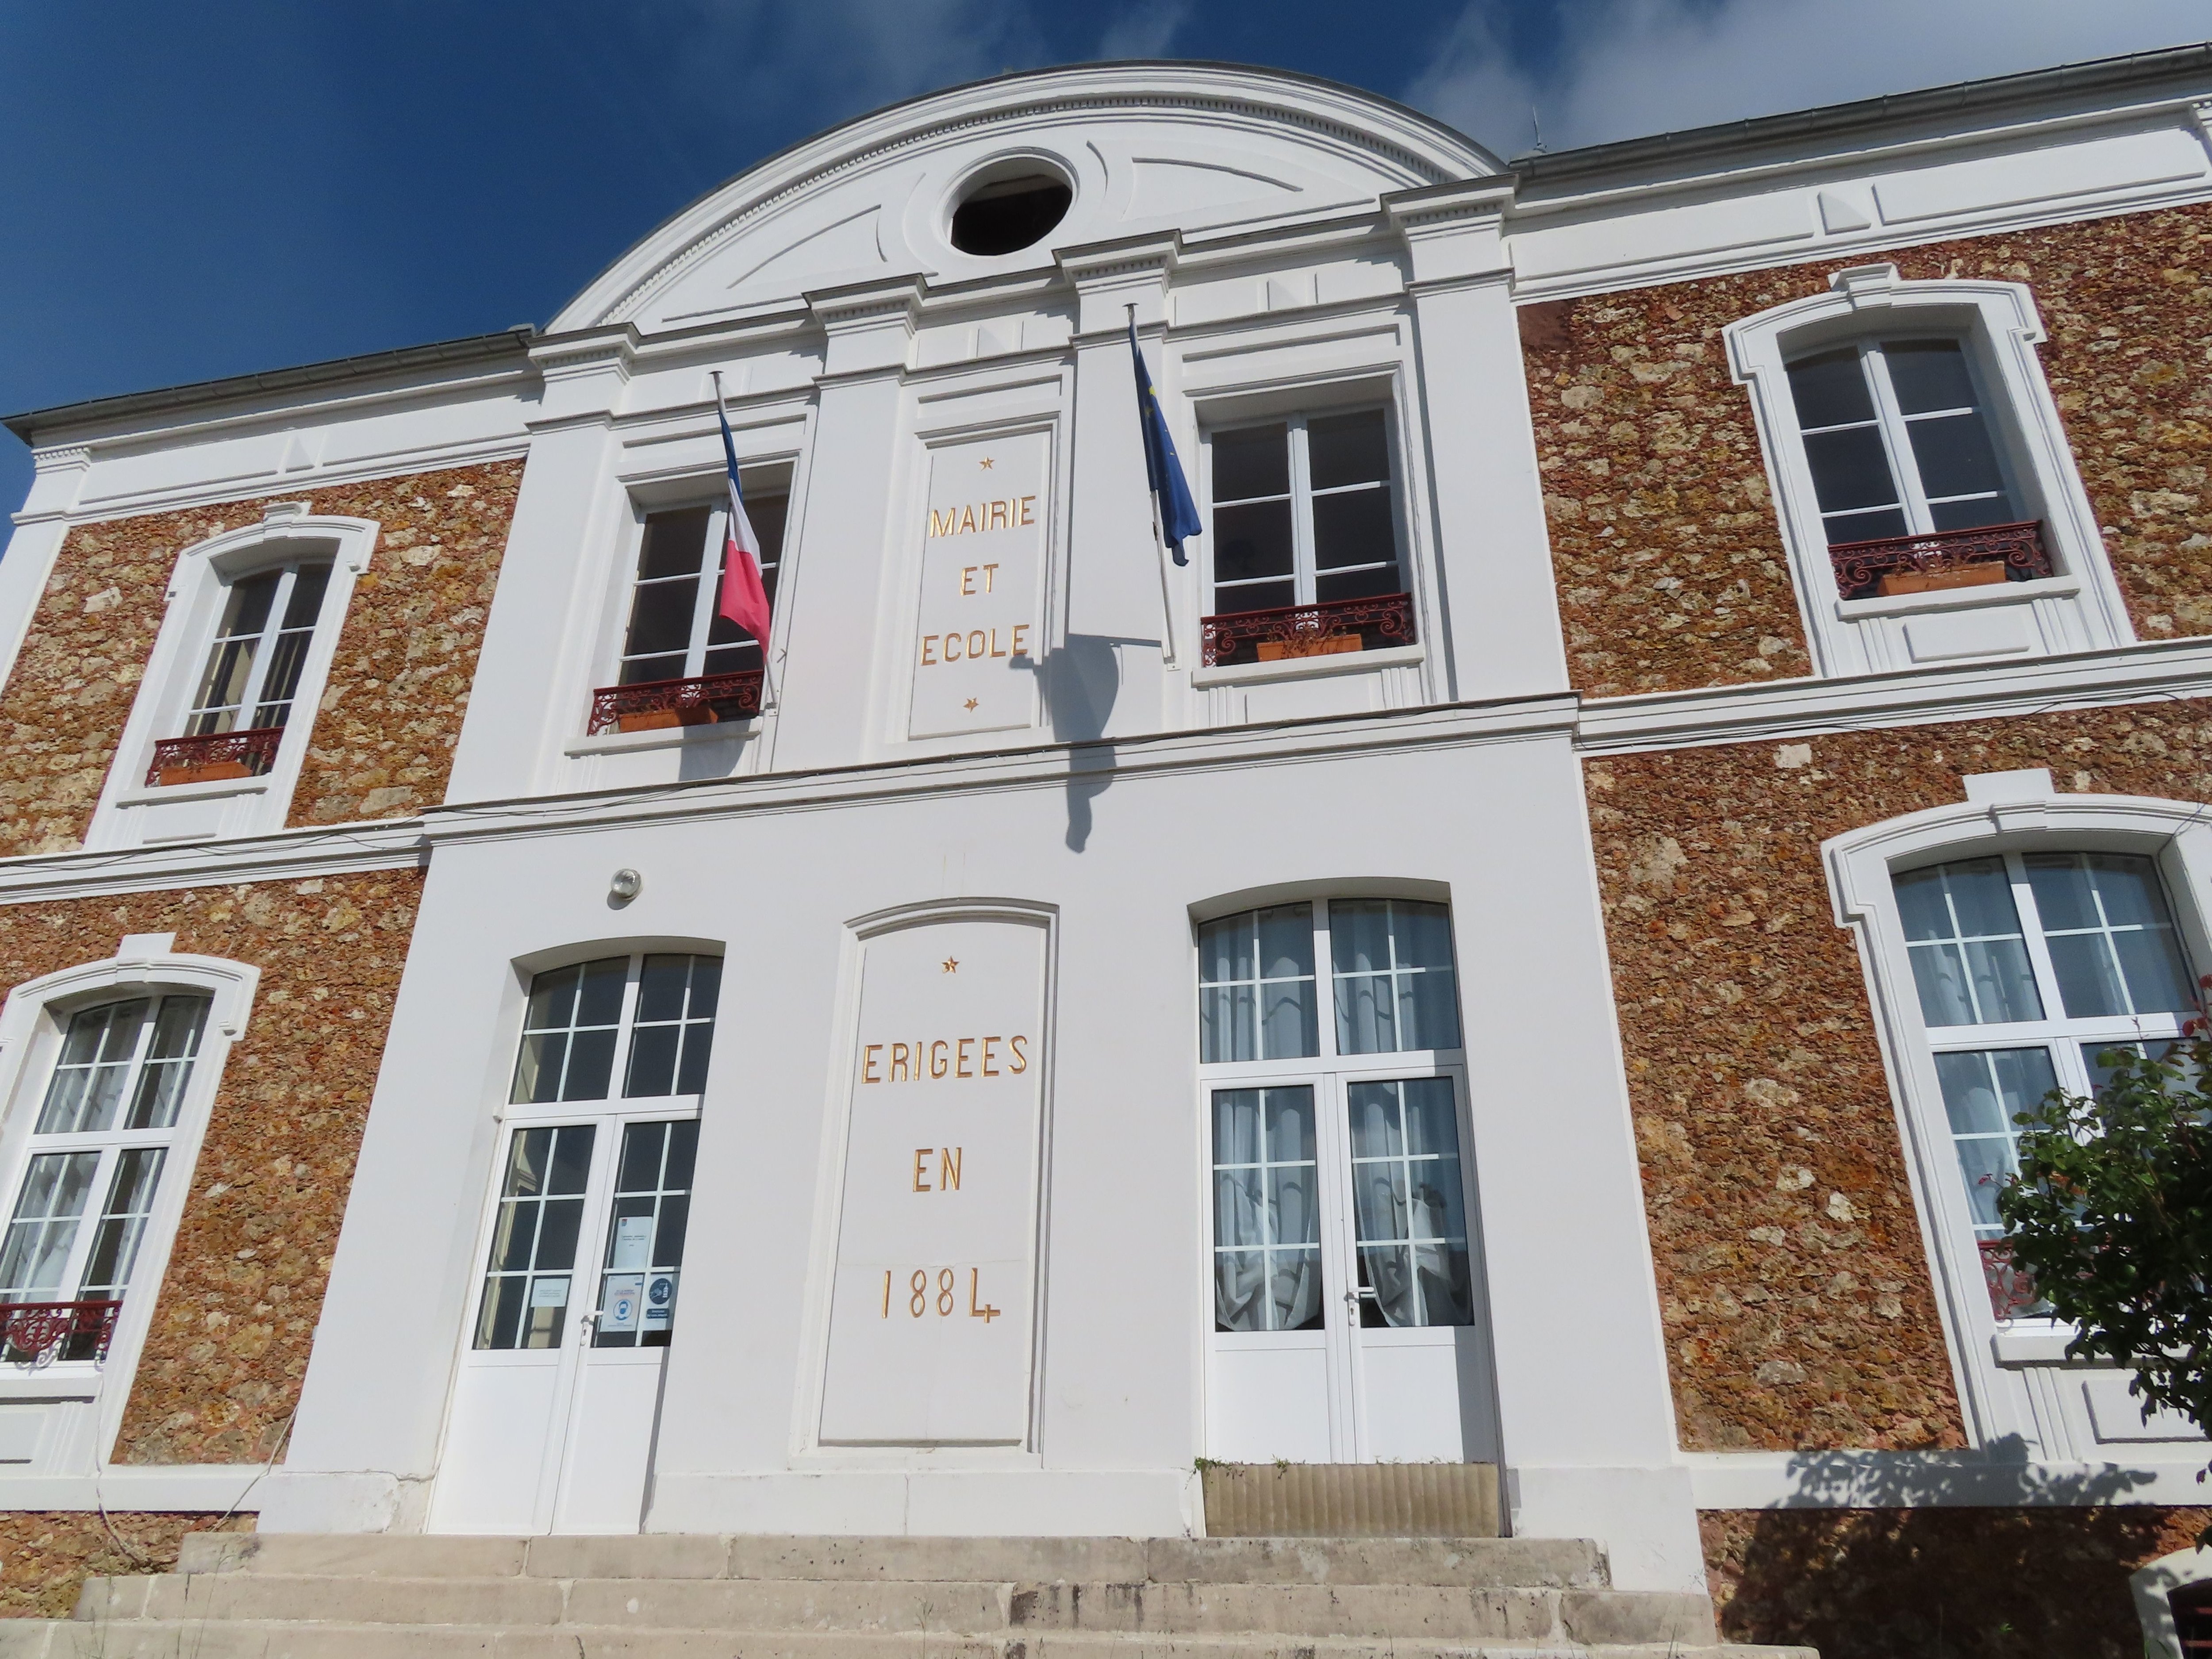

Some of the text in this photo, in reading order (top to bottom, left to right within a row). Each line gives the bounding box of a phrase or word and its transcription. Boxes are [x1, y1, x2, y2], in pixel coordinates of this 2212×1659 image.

[929, 495, 1035, 538] MAIRIE
[960, 563, 999, 596] ET
[920, 624, 1029, 666] ECOLE
[861, 1035, 1027, 1084] ERIGEES
[912, 1146, 962, 1192] EN
[881, 1267, 1001, 1324] 1884
